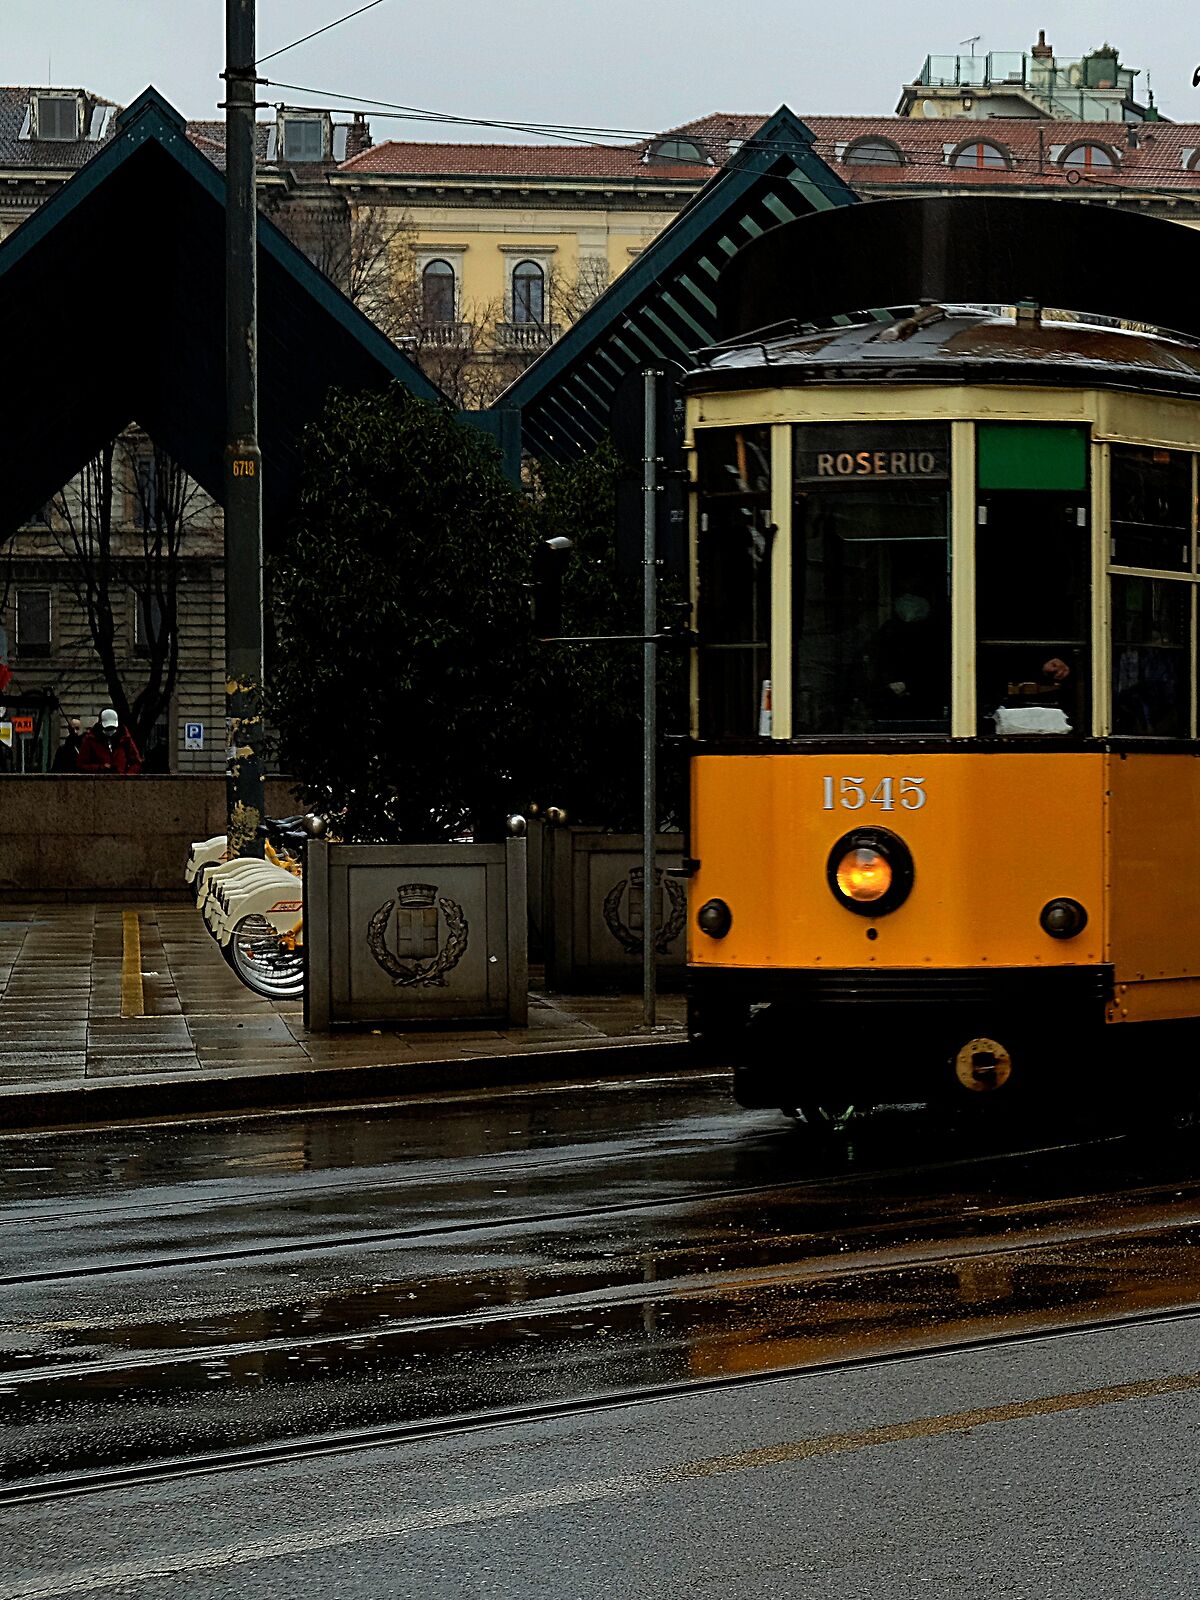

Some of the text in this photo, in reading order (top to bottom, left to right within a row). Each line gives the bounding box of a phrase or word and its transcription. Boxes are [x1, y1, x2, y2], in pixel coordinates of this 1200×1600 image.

[233, 460, 255, 477] 6718
[817, 452, 935, 475] ROSERIO
[188, 725, 199, 738] P
[823, 776, 927, 811] 1545
